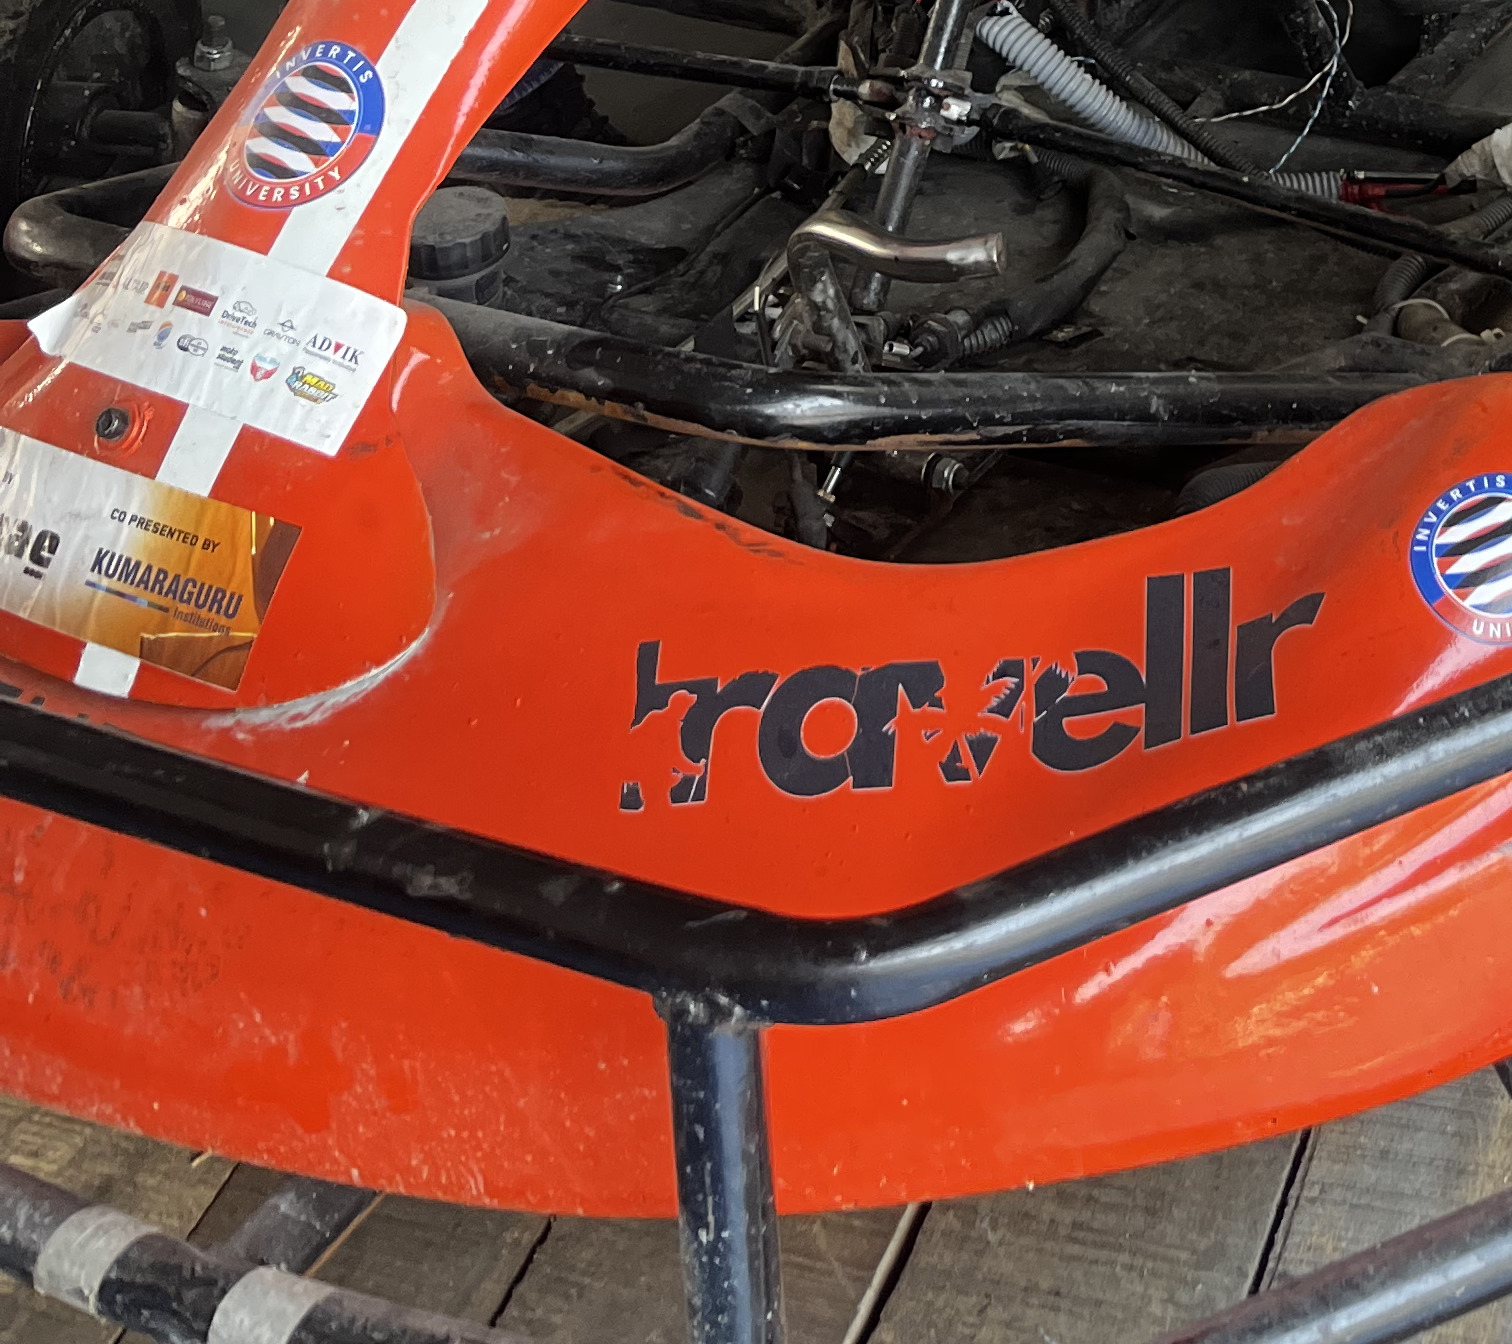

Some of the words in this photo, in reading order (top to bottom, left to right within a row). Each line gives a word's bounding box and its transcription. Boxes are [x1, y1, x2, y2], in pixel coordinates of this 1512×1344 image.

[276, 44, 373, 83] INVERTIS
[230, 159, 341, 202] UNIVERSITY
[302, 373, 335, 392] MAD
[110, 507, 127, 523] CO
[128, 513, 199, 548] PRESENTED
[201, 538, 221, 553] BY
[1413, 474, 1507, 552] INVERTIS
[90, 547, 244, 620] KUMARAGURU
